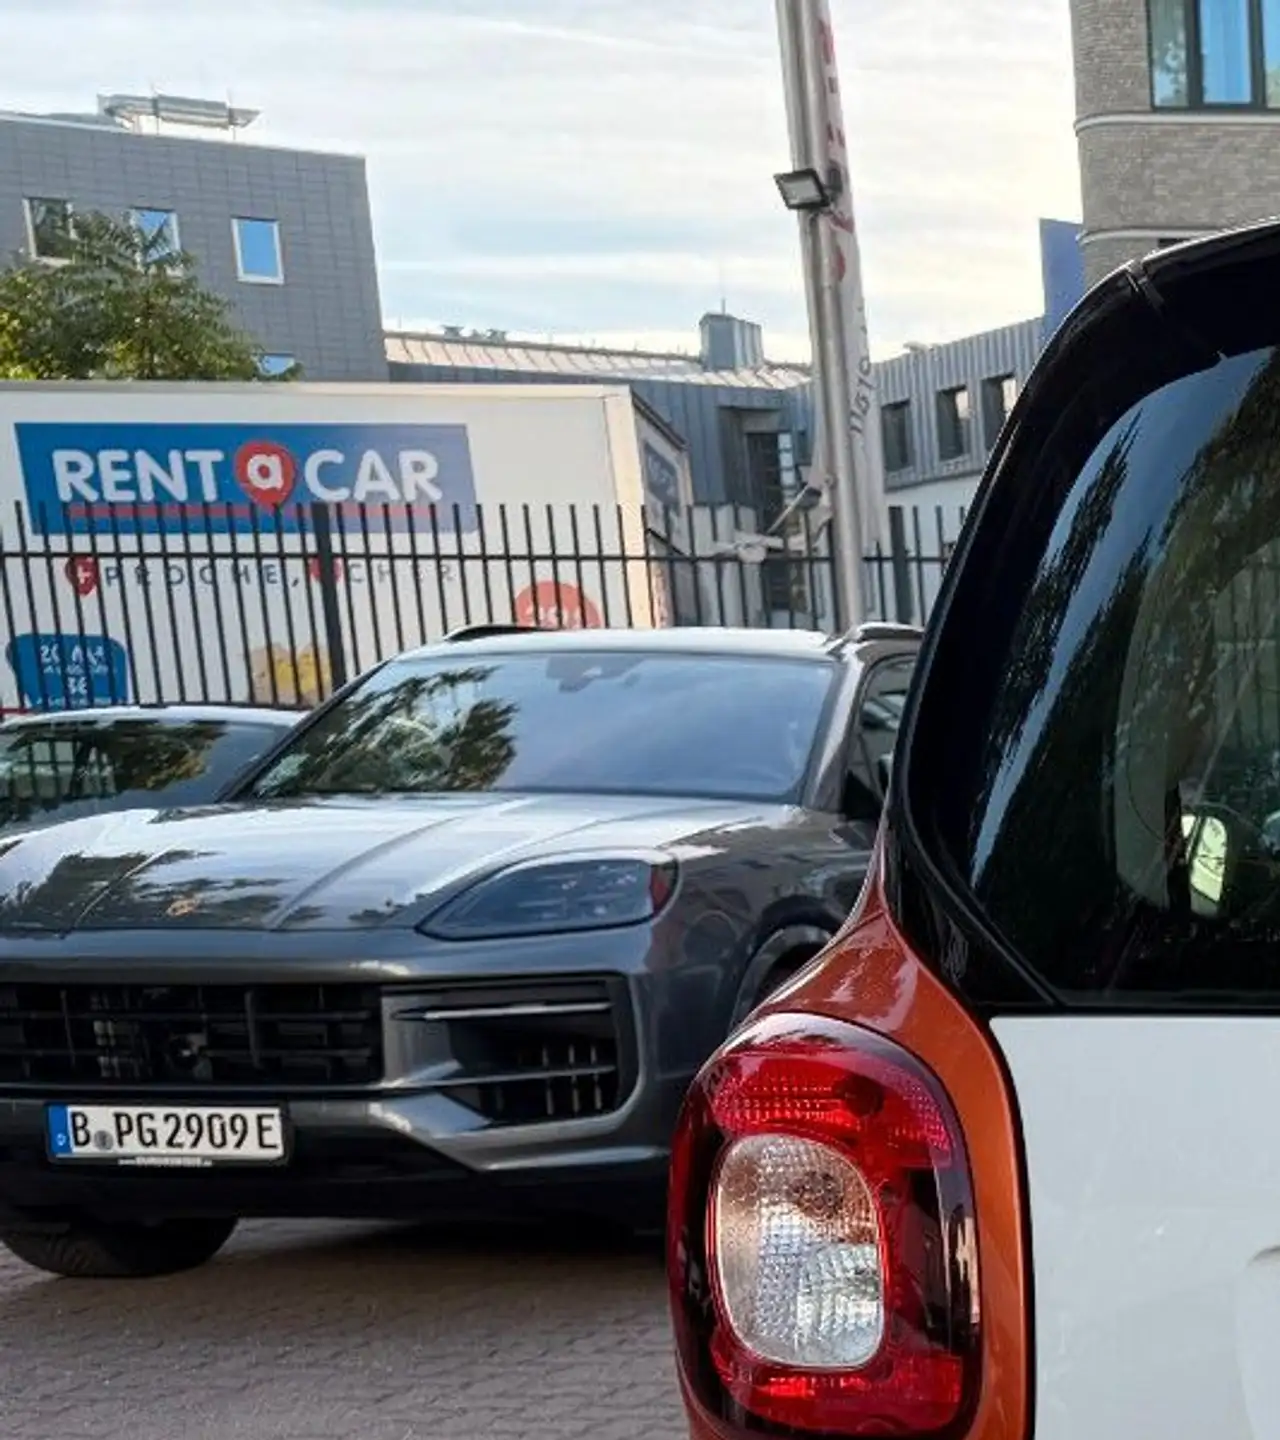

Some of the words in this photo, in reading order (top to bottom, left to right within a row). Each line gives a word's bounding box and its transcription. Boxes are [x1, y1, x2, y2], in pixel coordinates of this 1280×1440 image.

[51, 448, 224, 502] RENT
[246, 453, 284, 489] a
[303, 448, 443, 502] CAR
